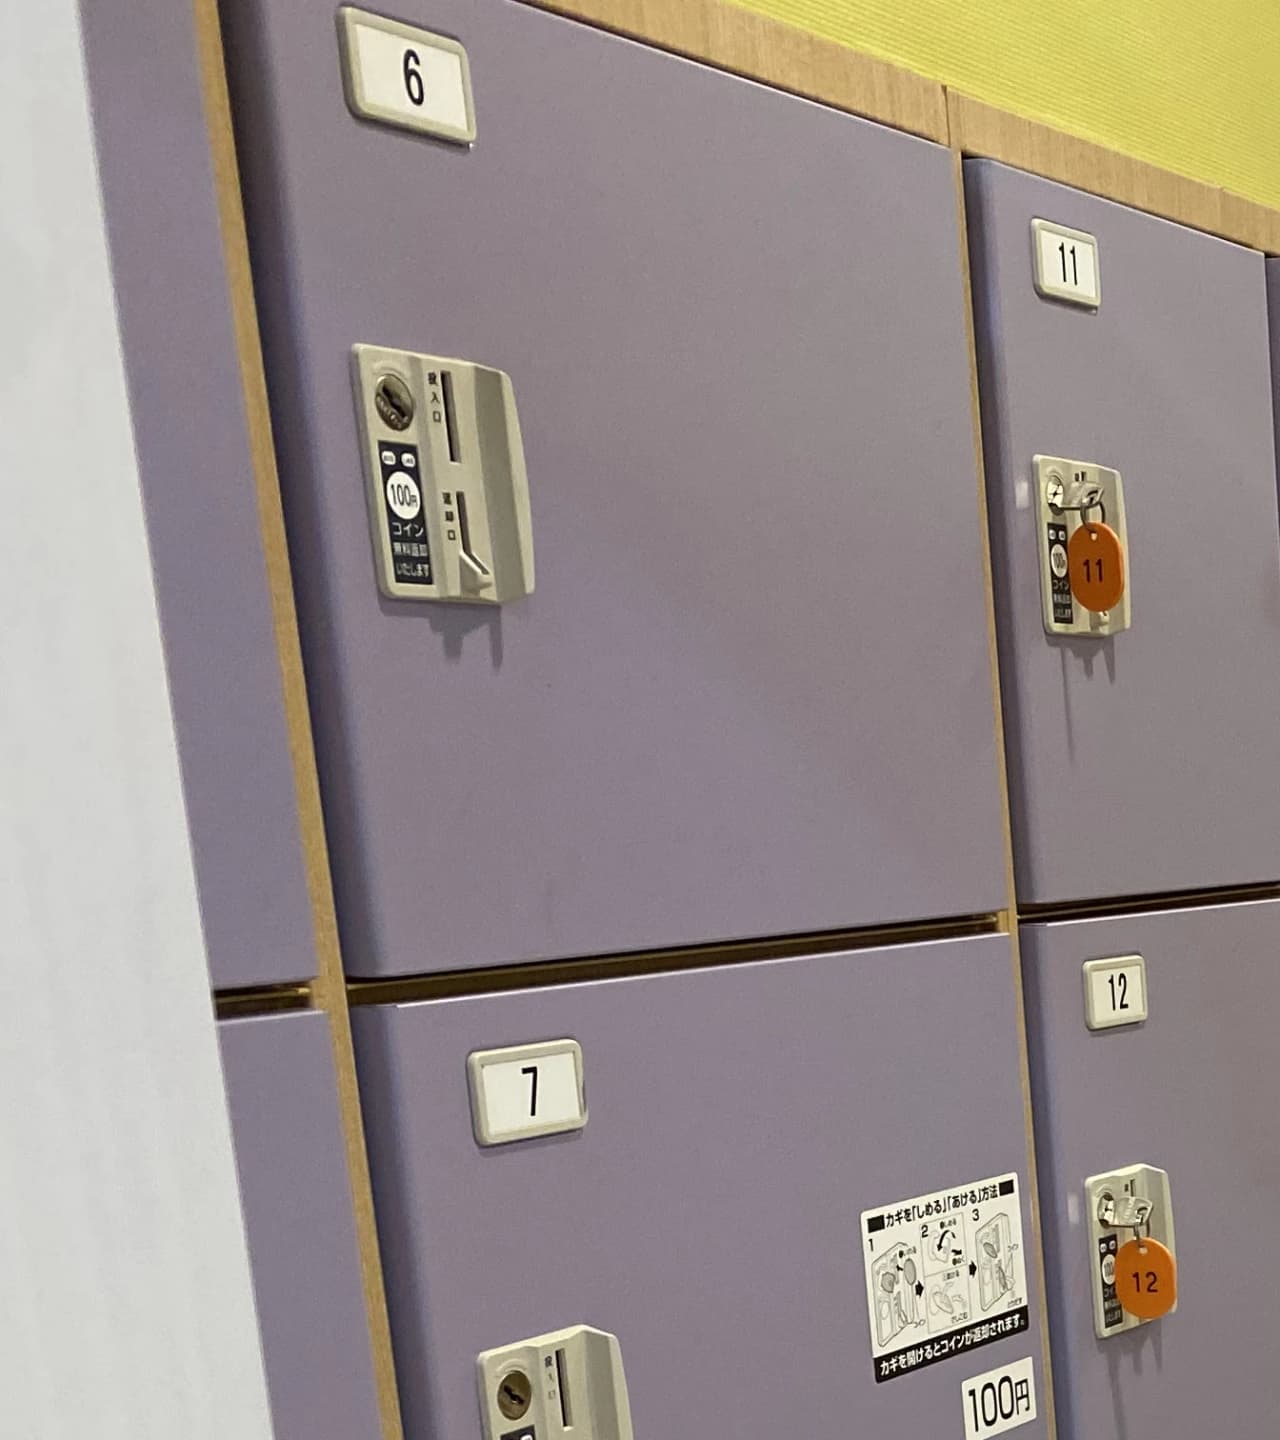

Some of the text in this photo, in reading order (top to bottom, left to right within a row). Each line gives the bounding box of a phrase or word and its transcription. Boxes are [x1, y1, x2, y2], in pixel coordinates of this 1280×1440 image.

[403, 49, 425, 106] 6
[1058, 242, 1078, 286] 11
[389, 483, 419, 509] 100円
[391, 521, 425, 538] コイン
[1082, 558, 1103, 583] 11
[1108, 972, 1129, 1011] 12
[521, 1066, 538, 1117] 7
[885, 1184, 999, 1228] カギを「しめる」「あける」方法
[868, 1208, 980, 1252] 1 2 3
[1132, 1271, 1158, 1293] 12
[967, 1375, 1031, 1433] 100円
